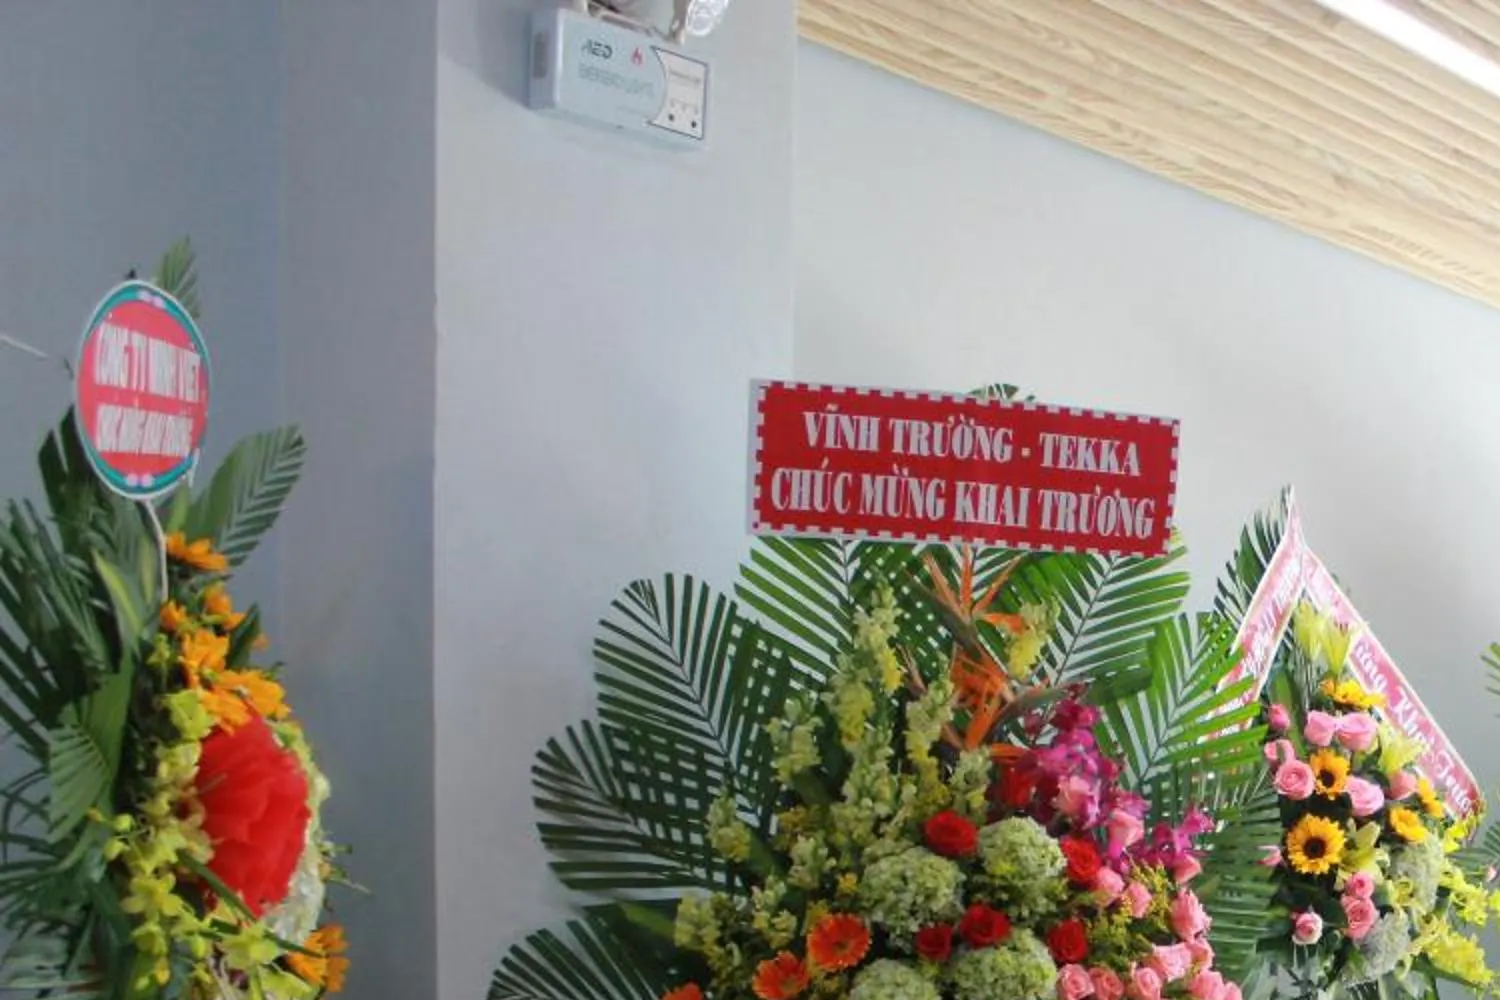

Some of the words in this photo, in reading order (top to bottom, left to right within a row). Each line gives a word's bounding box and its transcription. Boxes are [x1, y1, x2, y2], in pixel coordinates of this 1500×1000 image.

[803, 403, 880, 452] VĨNH
[889, 413, 1013, 463] TRƯỜNG
[1039, 432, 1141, 477] TEKKA
[771, 456, 853, 515] CHÚC
[858, 463, 946, 521] MỪNG
[954, 480, 1032, 527] KHAI
[1037, 484, 1156, 540] TRƯƠNG
